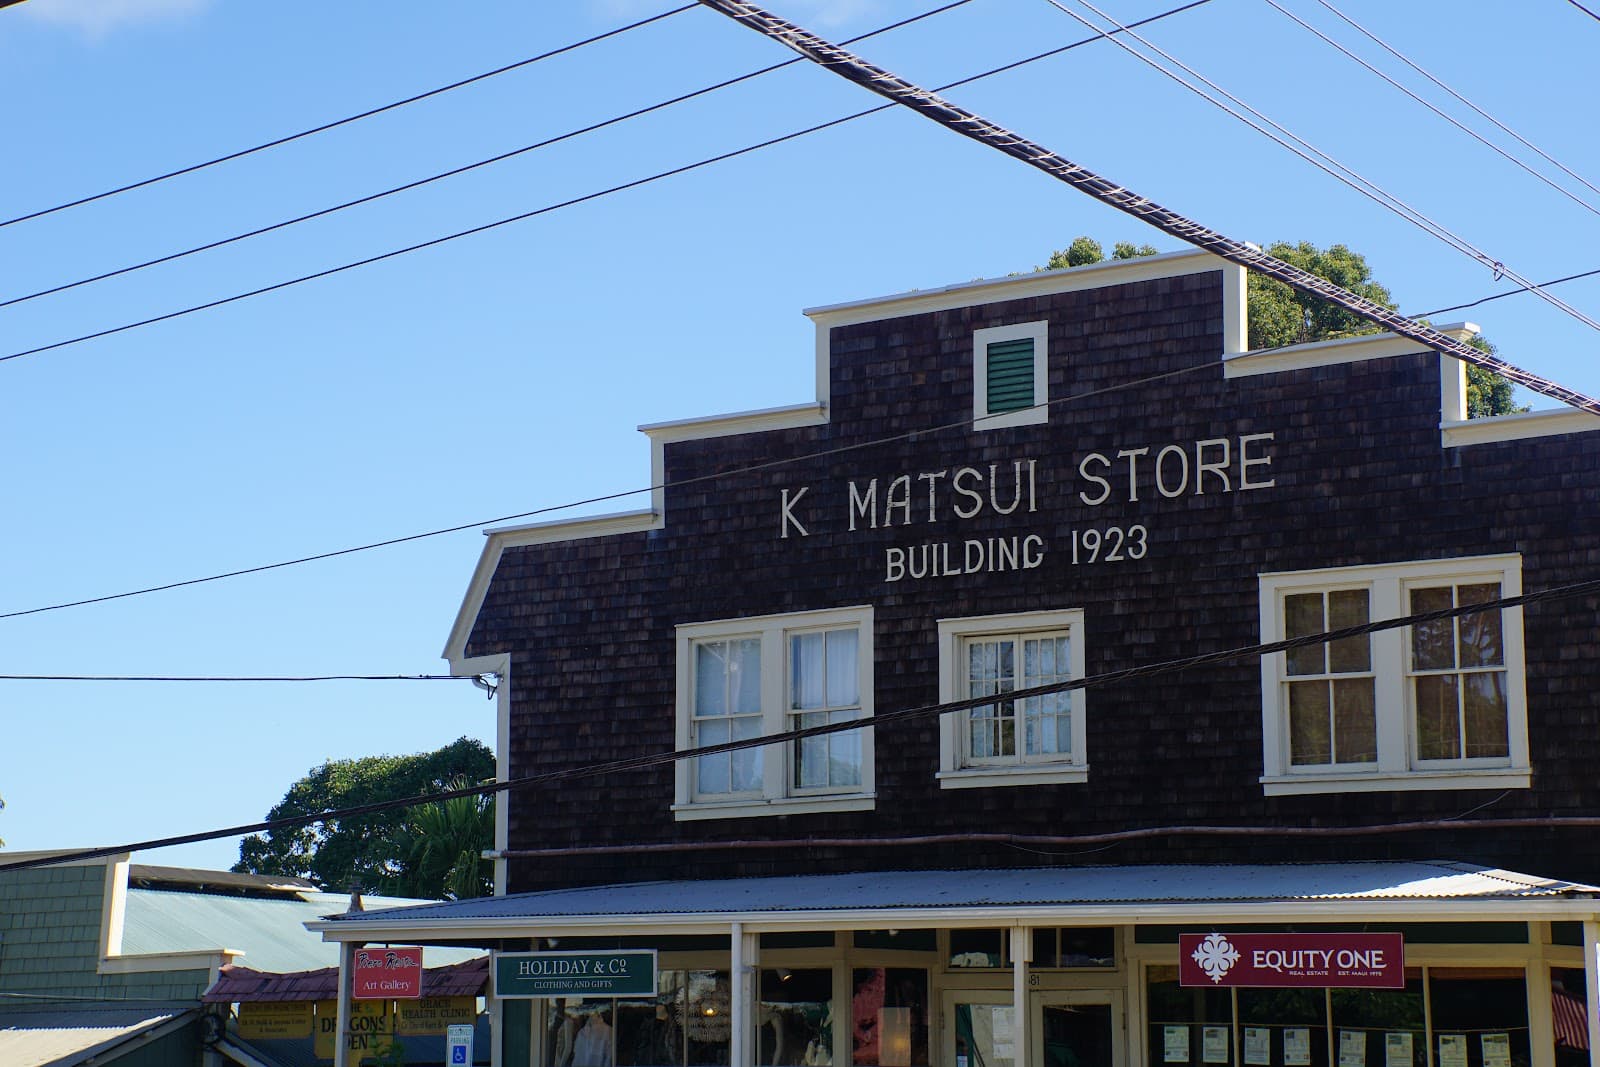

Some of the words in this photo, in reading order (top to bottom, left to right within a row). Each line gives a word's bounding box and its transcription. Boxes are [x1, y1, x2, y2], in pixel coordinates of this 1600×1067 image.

[780, 487, 809, 539] K
[847, 459, 1038, 533] MATSUI
[1079, 431, 1277, 506] STORE
[885, 534, 1044, 583] BUILDING
[1071, 524, 1148, 566] 1923
[519, 959, 590, 975] HOLIDAY
[593, 960, 605, 974] &
[1252, 949, 1335, 973] EQUITY
[1336, 949, 1388, 969] ONE
[363, 981, 377, 990] Art
[380, 979, 409, 991] Gallery
[534, 980, 573, 989] CLOTHING
[574, 980, 590, 988] AND
[591, 980, 613, 988] GIFTS
[402, 1008, 436, 1019] HEALTH
[440, 1007, 471, 1018] CLINIC
